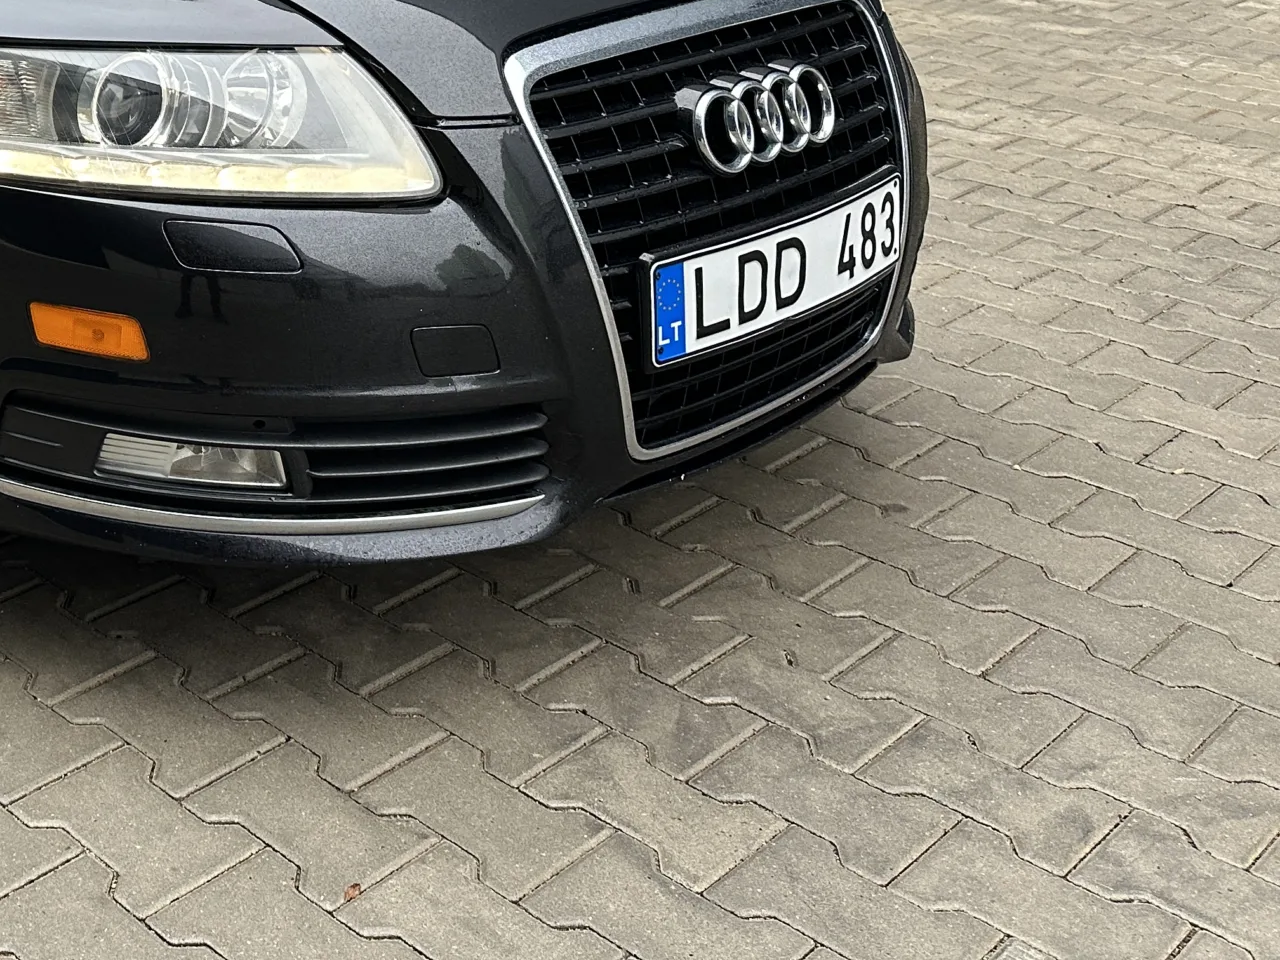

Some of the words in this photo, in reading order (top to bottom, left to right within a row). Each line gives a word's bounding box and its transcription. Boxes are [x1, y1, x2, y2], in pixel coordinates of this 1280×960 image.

[695, 237, 807, 339] LDD
[837, 191, 895, 279] 483
[658, 321, 682, 345] LT
